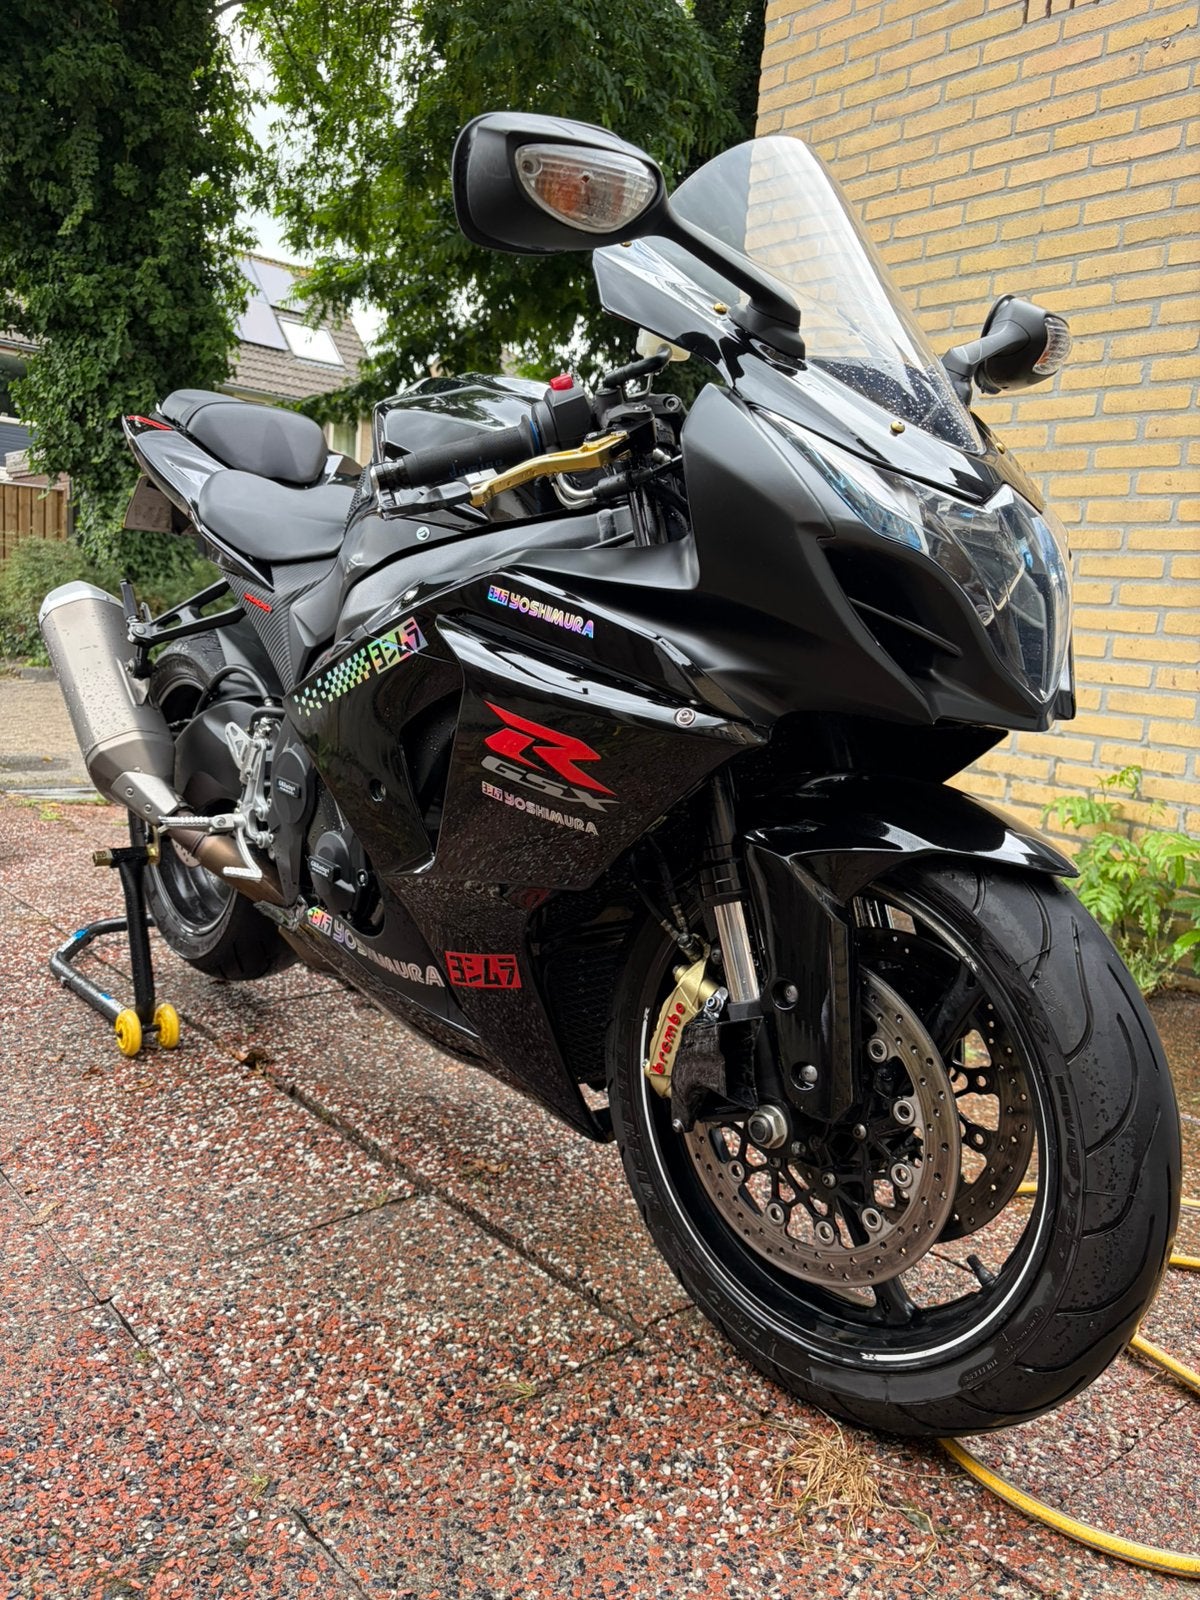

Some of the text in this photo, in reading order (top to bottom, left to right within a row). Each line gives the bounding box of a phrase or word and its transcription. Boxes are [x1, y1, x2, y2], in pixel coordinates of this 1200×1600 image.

[508, 592, 594, 638] YOSHIMURA
[481, 755, 621, 813] GSX
[504, 791, 599, 836] YOSHIMURA
[332, 919, 445, 987] YOSHIMURA
[651, 1002, 685, 1075] brembo
